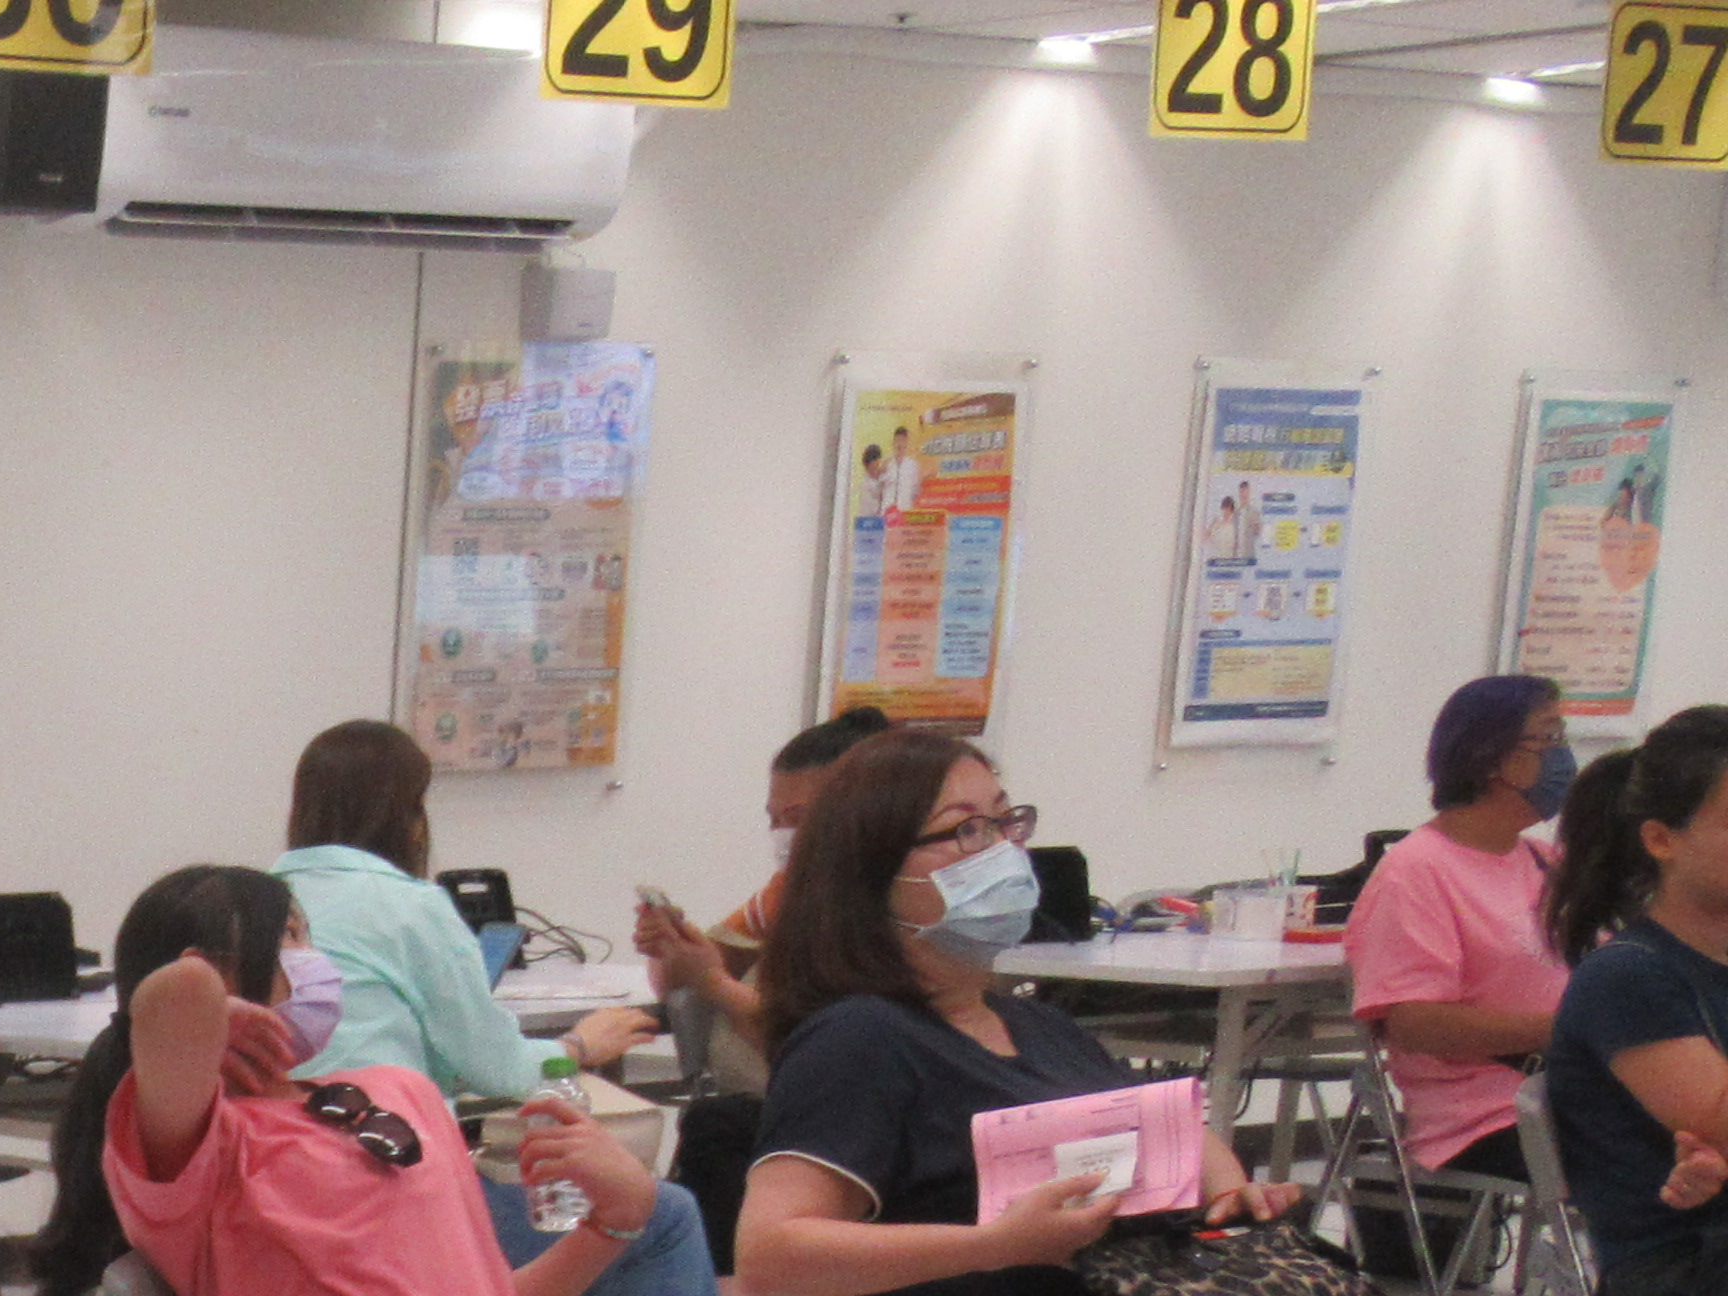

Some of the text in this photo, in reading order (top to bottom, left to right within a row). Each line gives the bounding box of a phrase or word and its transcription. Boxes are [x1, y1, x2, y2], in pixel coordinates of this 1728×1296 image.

[561, 0, 714, 82] 29
[1166, 0, 1295, 118] 28
[1613, 19, 1728, 147] 27
